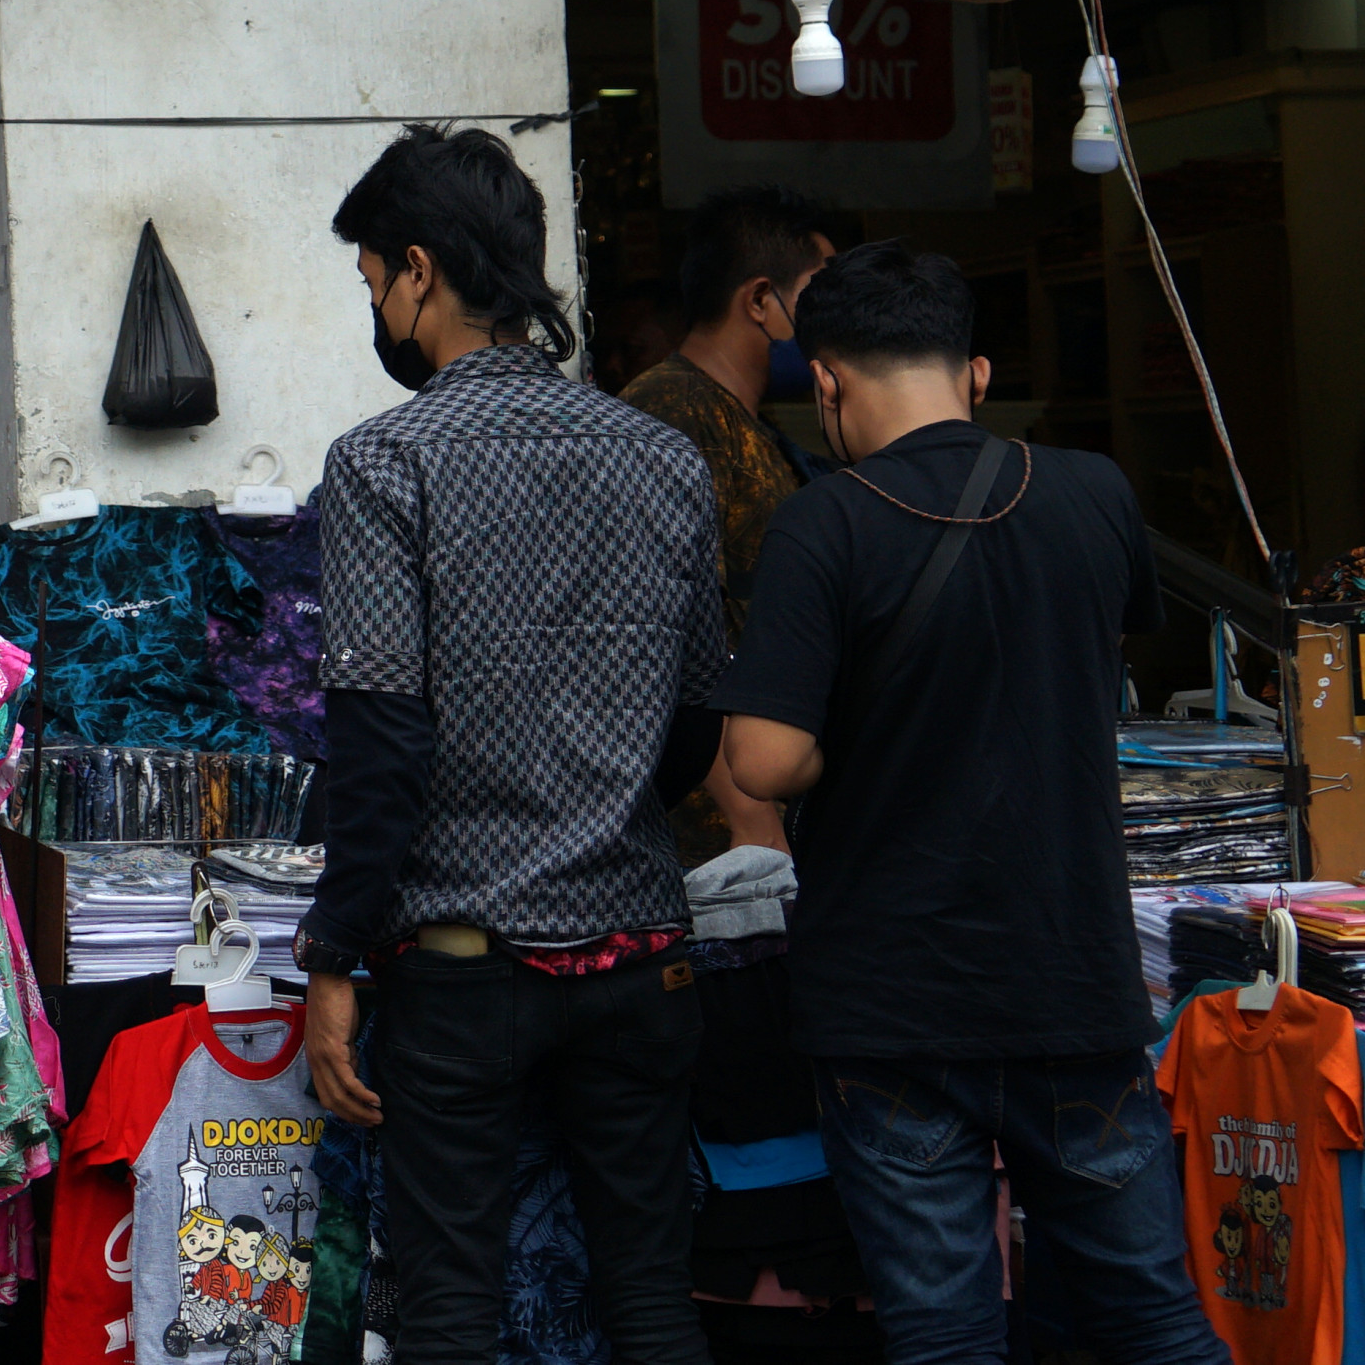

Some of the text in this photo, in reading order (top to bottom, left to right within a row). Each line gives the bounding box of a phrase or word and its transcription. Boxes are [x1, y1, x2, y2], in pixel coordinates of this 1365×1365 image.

[723, 58, 919, 101] DISUNT
[215, 1147, 279, 1162] FOREVER
[210, 1160, 287, 1177] TOGETHER
